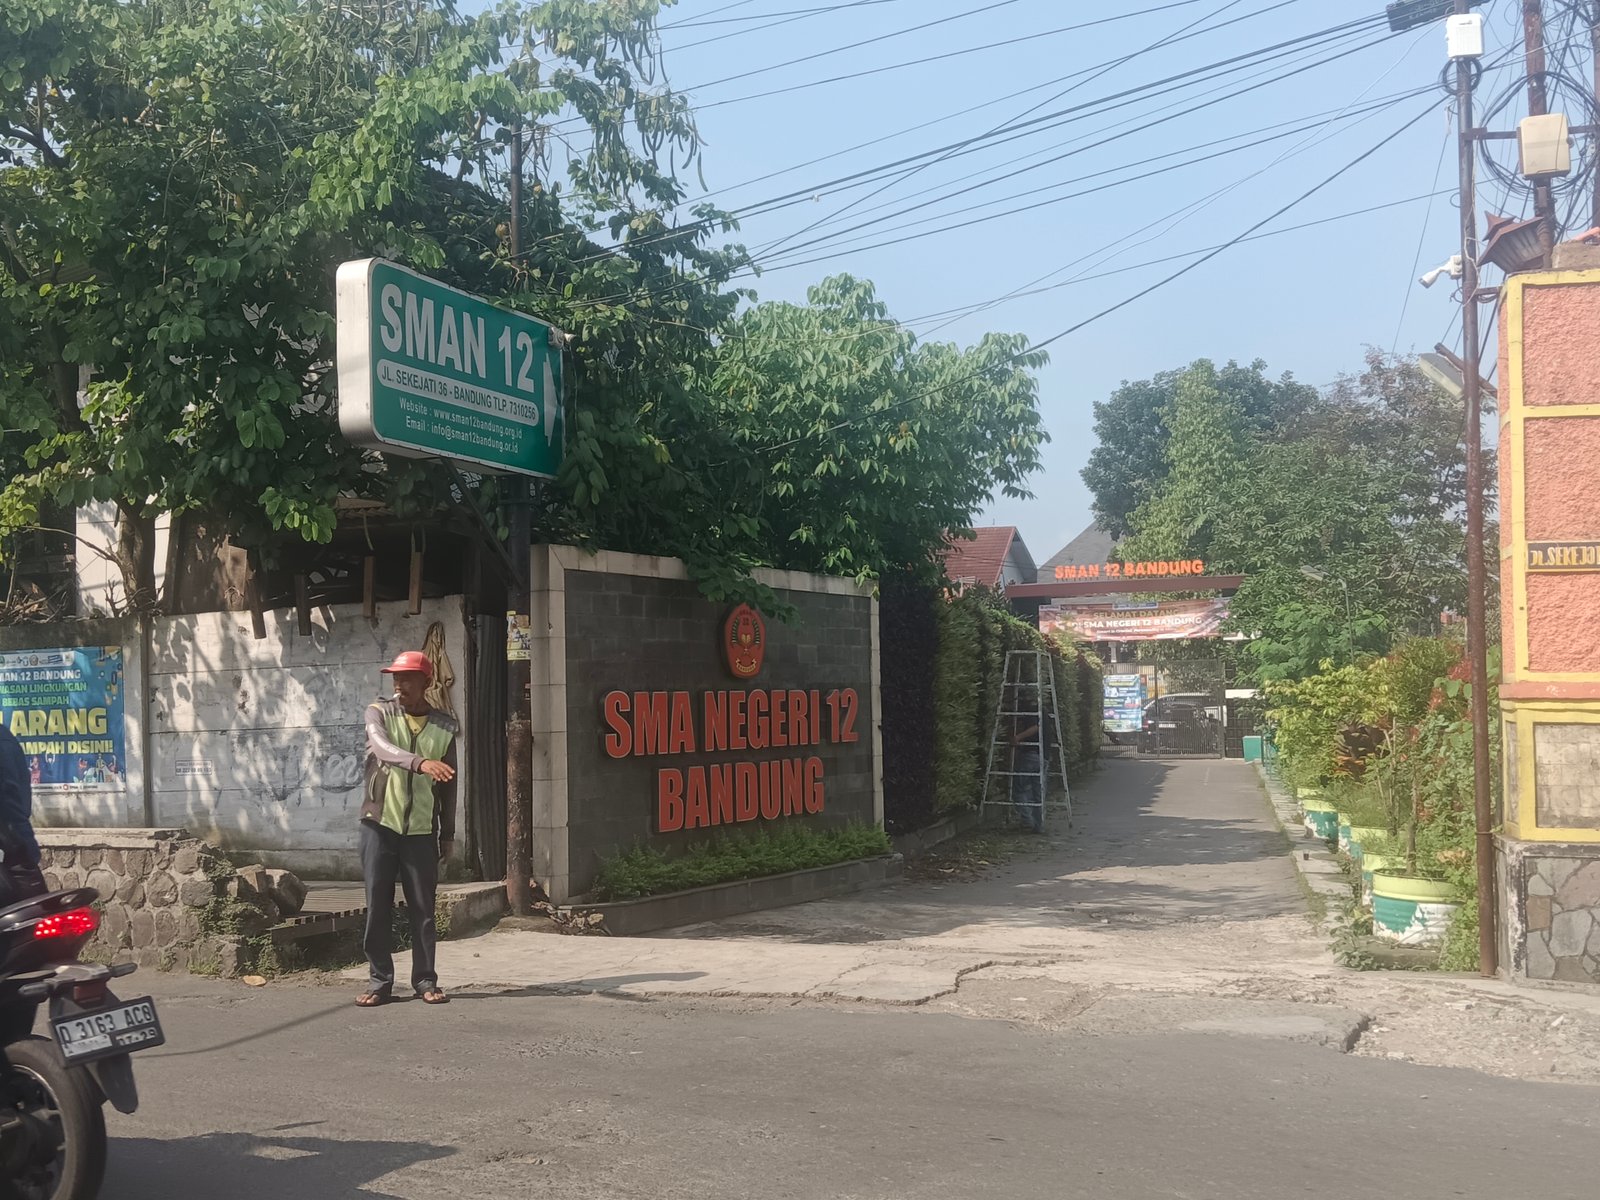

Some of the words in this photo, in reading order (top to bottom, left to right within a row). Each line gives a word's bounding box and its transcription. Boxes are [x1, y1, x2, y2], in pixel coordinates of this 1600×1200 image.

[380, 283, 487, 379] SMAN
[498, 326, 534, 393] 12
[381, 366, 394, 382] JL.
[396, 370, 437, 392] SEKEJATI
[438, 382, 448, 396] 36
[454, 385, 492, 408] BANDUNG
[492, 397, 508, 413] TLP.
[509, 401, 536, 420] 7310256
[400, 398, 428, 416] Website
[405, 416, 426, 431] Email
[1055, 564, 1099, 579] SMAN
[1104, 562, 1120, 577] 12
[1124, 559, 1204, 577] BANDUNG
[1083, 619, 1104, 628] SMA
[1105, 618, 1140, 627] NEGERI
[1141, 619, 1152, 627] 12
[1153, 616, 1202, 627] BANDUNG
[1093, 611, 1137, 620] SELAMAT
[20, 671, 31, 681] 12
[33, 669, 81, 680] BANDUNG
[28, 682, 87, 693] LINGKUNGAN
[2, 697, 30, 707] BEBAS
[31, 695, 69, 706] SAMPAH
[603, 690, 696, 758] SMA
[704, 689, 821, 751] NEGERI
[826, 688, 859, 743] 12
[658, 756, 825, 833] BANDUNG
[59, 1026, 72, 1047] D
[75, 1014, 115, 1039] 3163
